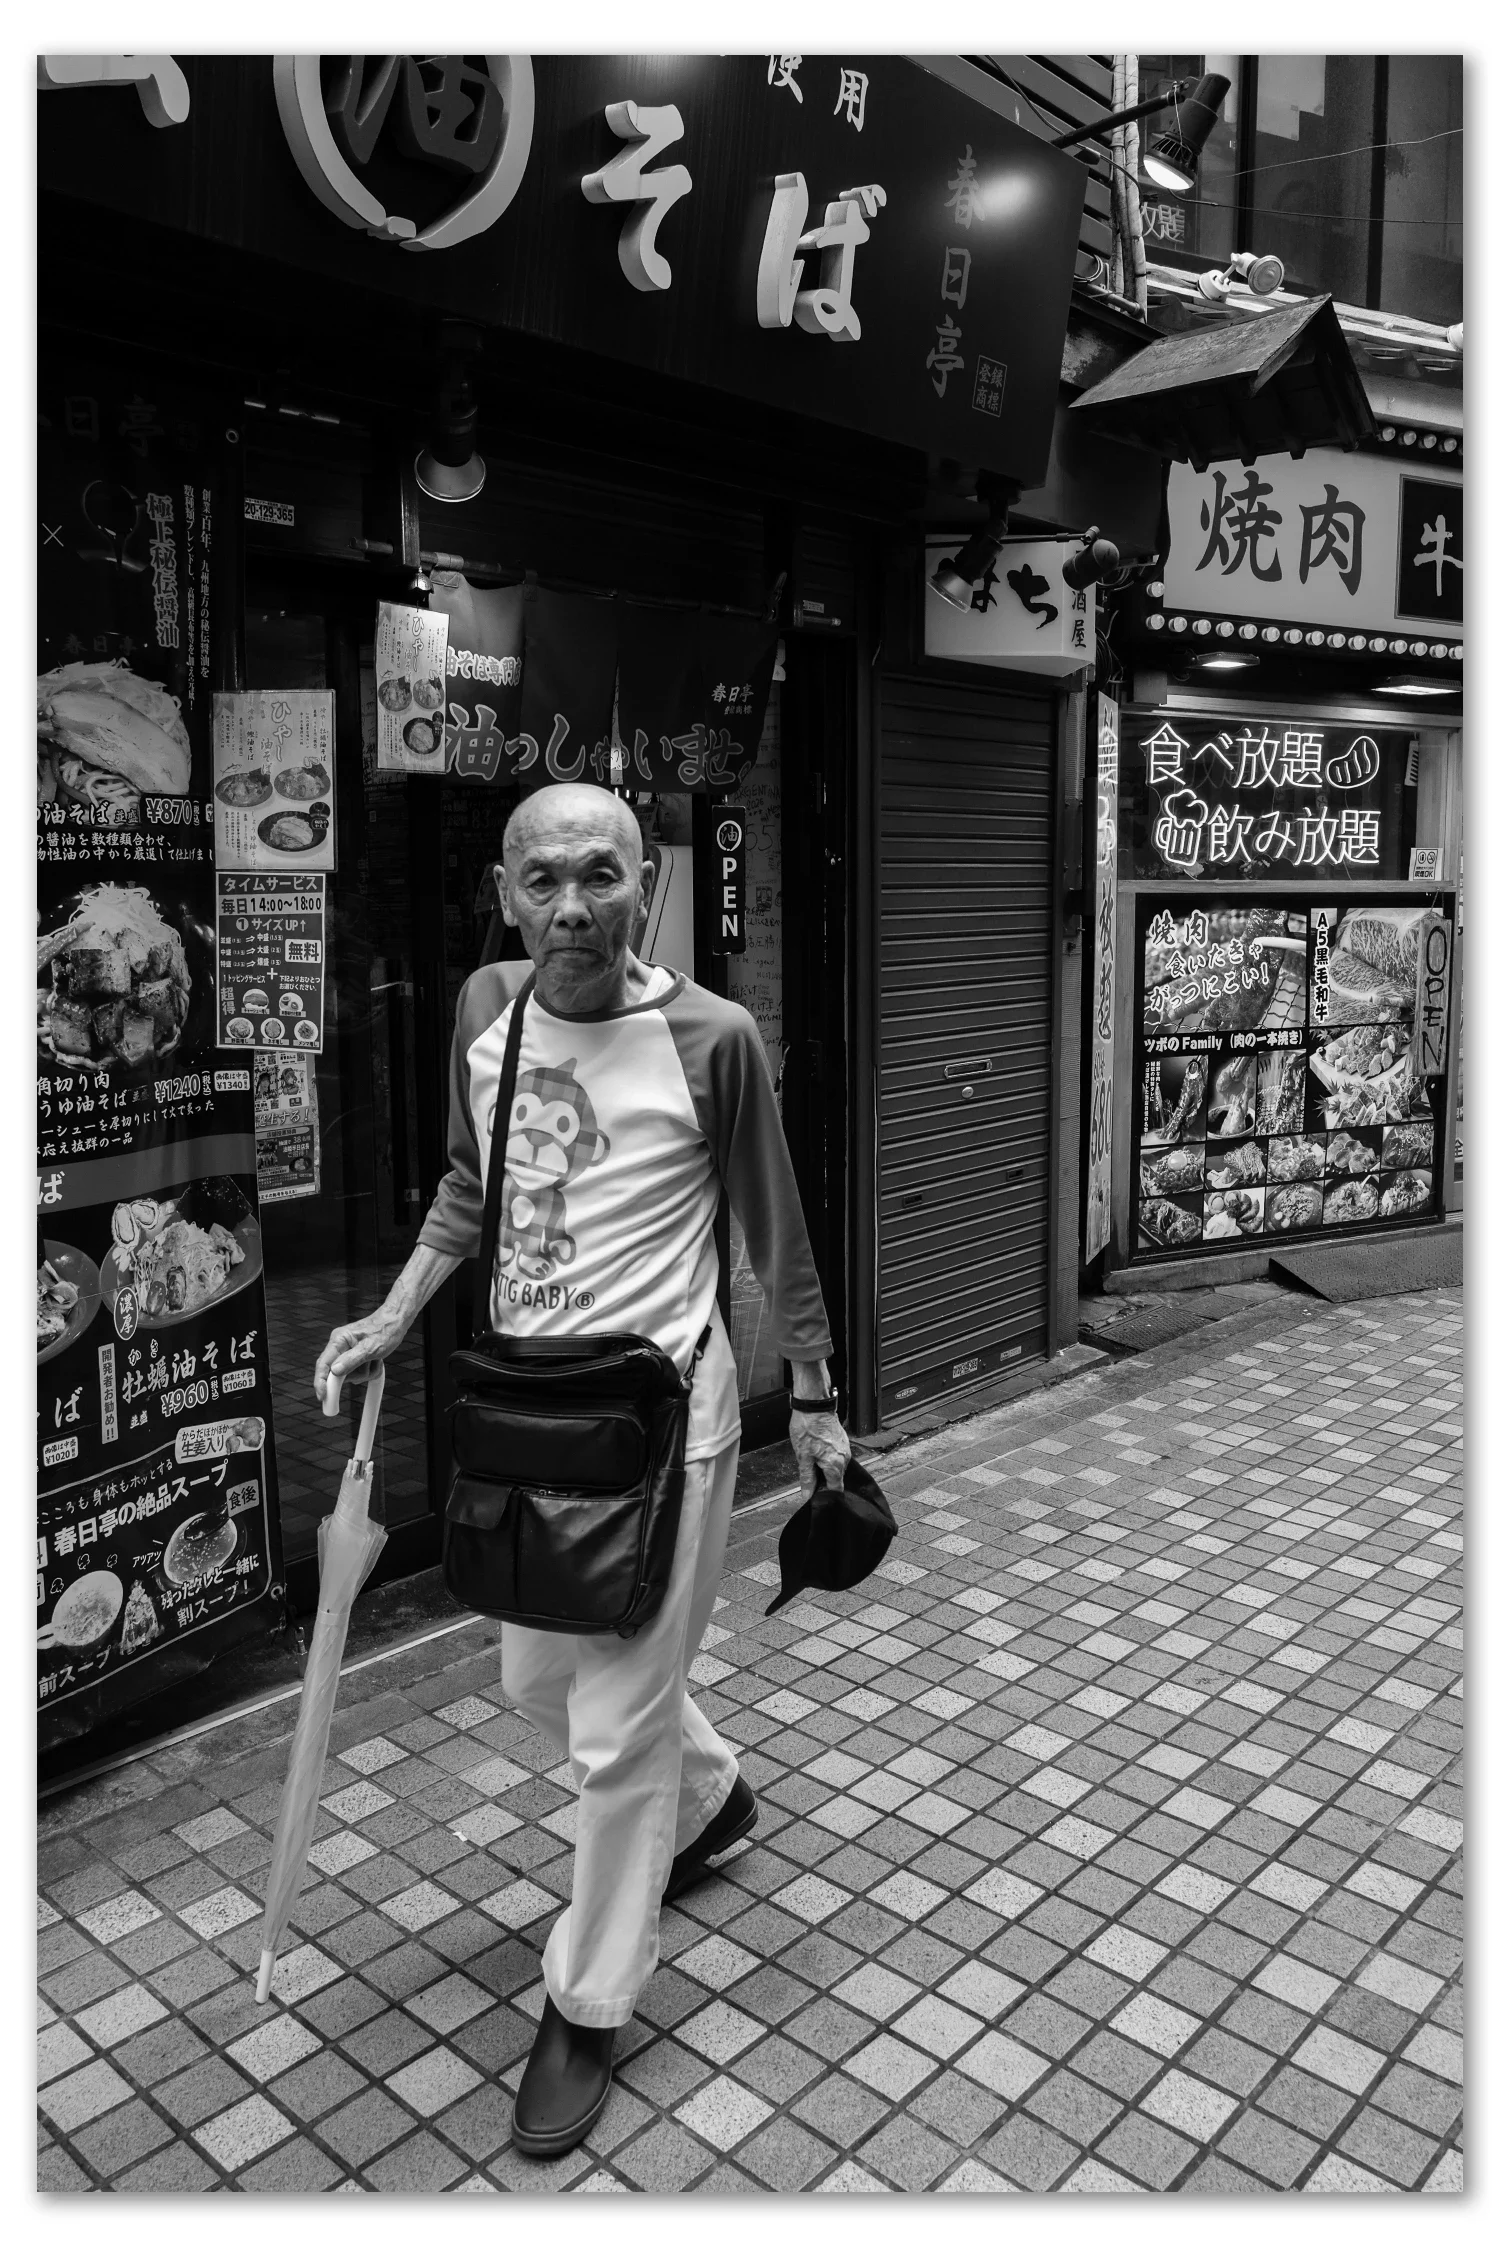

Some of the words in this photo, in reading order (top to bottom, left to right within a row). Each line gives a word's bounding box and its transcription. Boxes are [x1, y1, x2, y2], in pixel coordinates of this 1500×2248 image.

[926, 144, 985, 398] 春日亭
[1195, 470, 1367, 596] 焼肉
[1413, 514, 1463, 597] 牛
[711, 682, 755, 704] 春日亭
[260, 737, 274, 776] 油そば
[1139, 721, 1325, 788] 食べ放題
[145, 798, 192, 825] ¥870
[1207, 803, 1382, 866] 飲み放題
[224, 876, 318, 893] タイムサービス
[1150, 909, 1209, 948] 焼肉
[288, 941, 320, 962] 無料
[1165, 938, 1263, 978] 食いたきゃ
[1313, 910, 1331, 1022] A5黒毛和牛
[280, 975, 321, 983] 下記よりおひとつ
[1422, 926, 1448, 1070] OPEN
[220, 986, 236, 1015] 超得
[1182, 1035, 1223, 1050] Family
[37, 1070, 110, 1096] 角切り肉
[40, 1088, 127, 1118] うゆ油そば
[154, 1073, 201, 1103] ¥1240
[118, 1294, 134, 1335] 濃厚
[121, 1330, 258, 1405] 牡蠣油そば
[54, 1386, 83, 1428] ば
[160, 1379, 209, 1417] ¥960
[181, 1435, 224, 1459] 生姜入り
[53, 1458, 229, 1557] 春日亭の絶品スープ
[228, 1485, 258, 1511] 食後
[177, 1579, 249, 1628] 割スープ!
[39, 1644, 112, 1698] 前スープ
